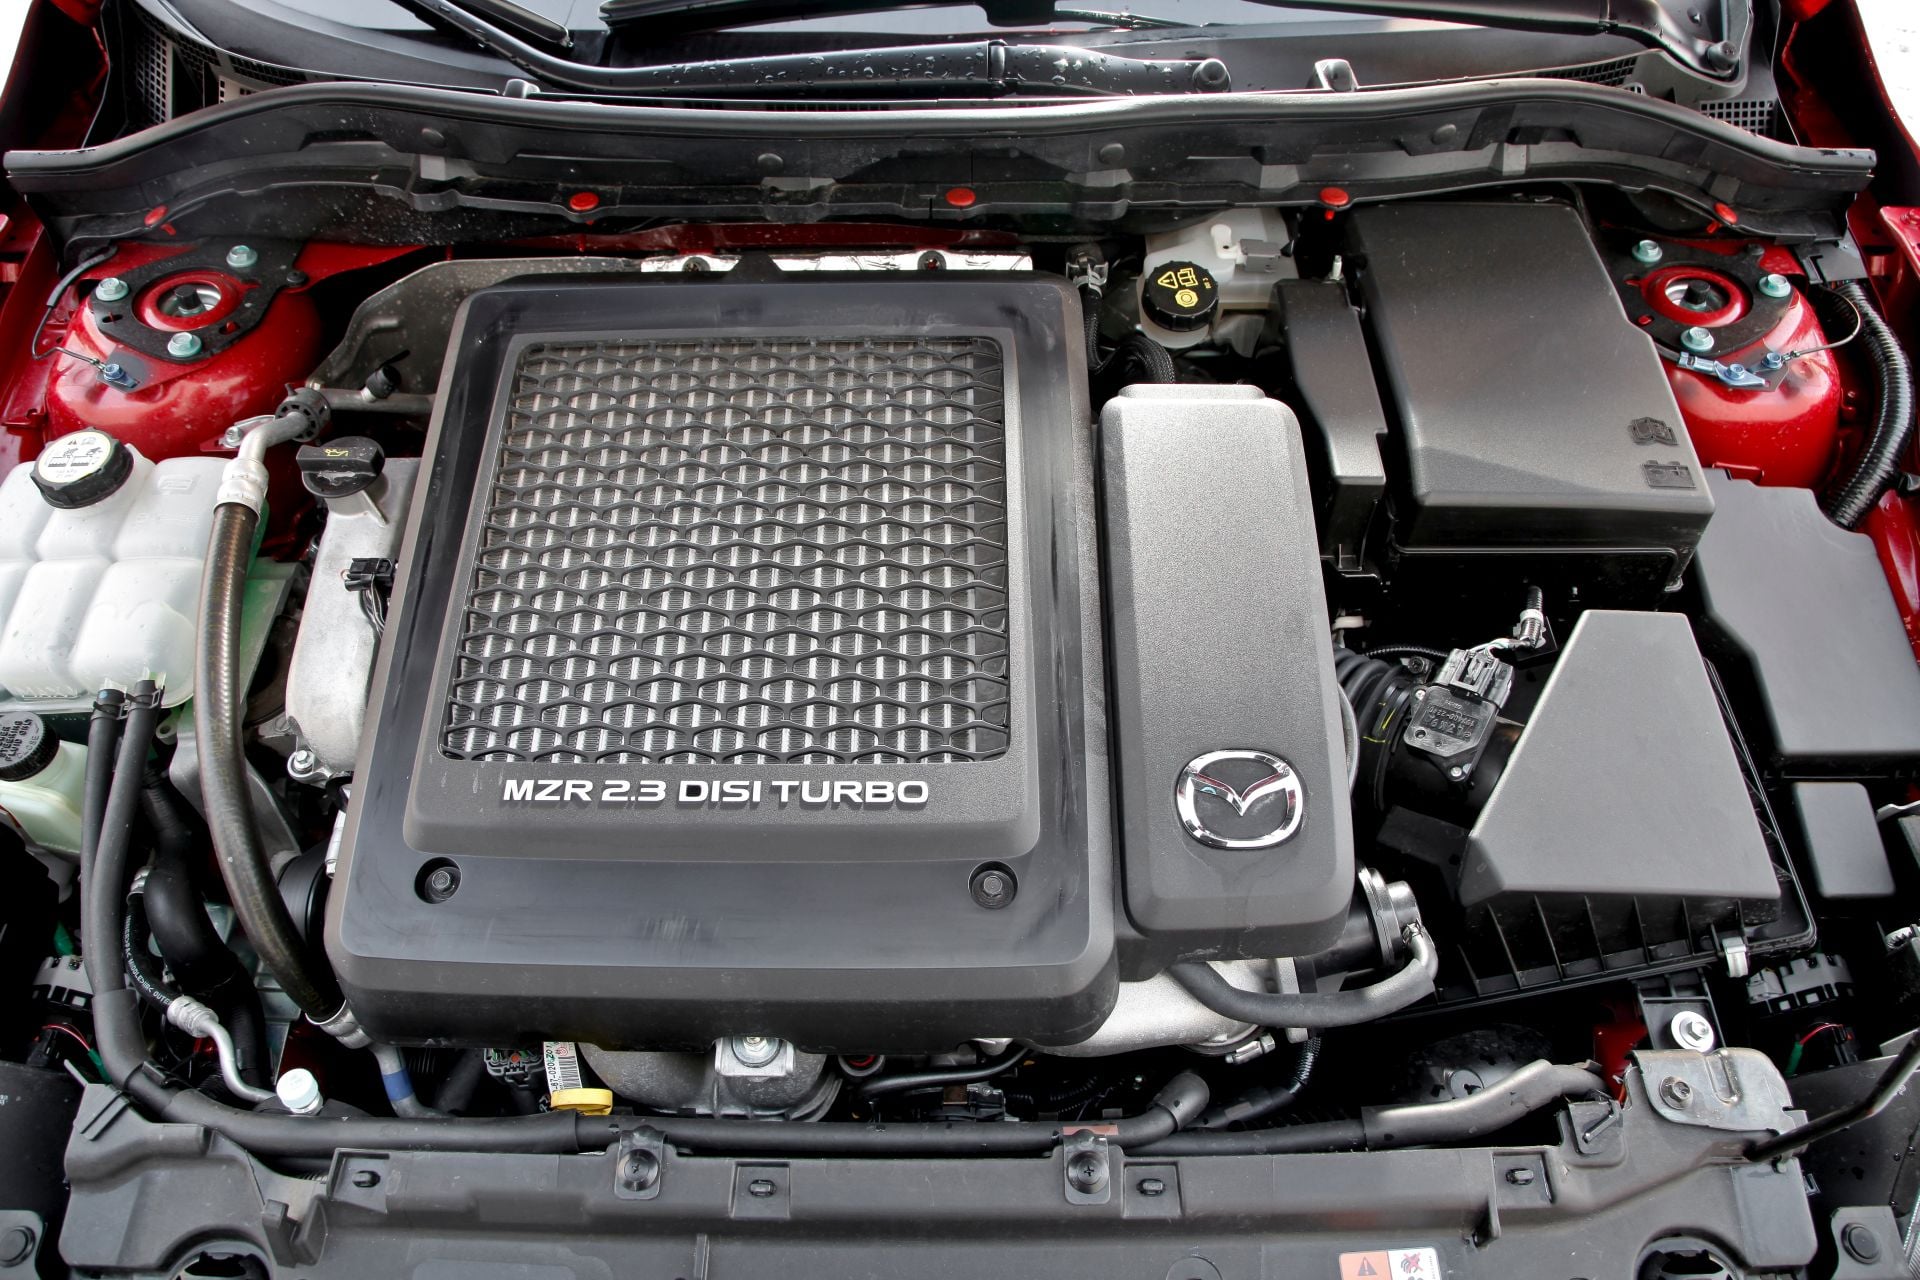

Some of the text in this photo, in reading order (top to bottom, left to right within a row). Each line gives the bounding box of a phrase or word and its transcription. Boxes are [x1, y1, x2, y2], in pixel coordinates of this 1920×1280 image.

[504, 780, 928, 802] MZR 2.3 DISI TURBO
